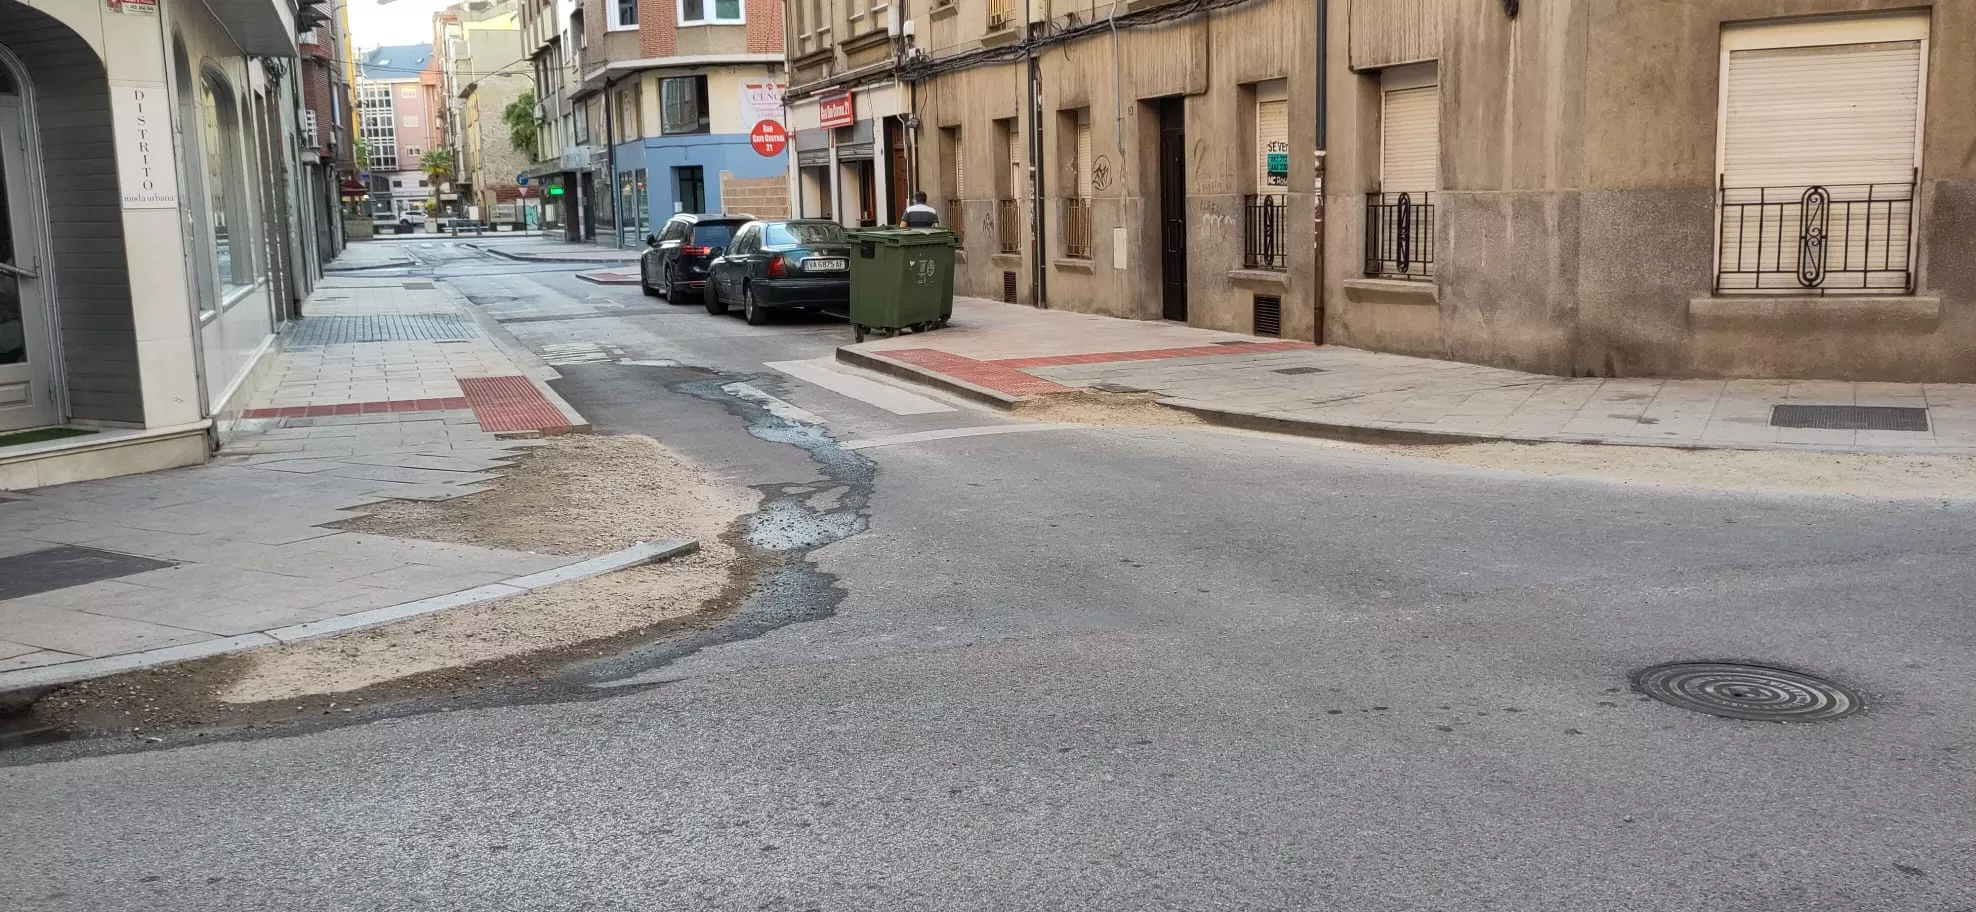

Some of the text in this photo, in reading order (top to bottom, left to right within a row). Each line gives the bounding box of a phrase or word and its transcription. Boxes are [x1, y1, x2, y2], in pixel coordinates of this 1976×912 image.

[134, 90, 153, 191] DISTRITO
[766, 144, 773, 152] 21
[1268, 141, 1277, 152] SE
[124, 192, 174, 202] moda urbana
